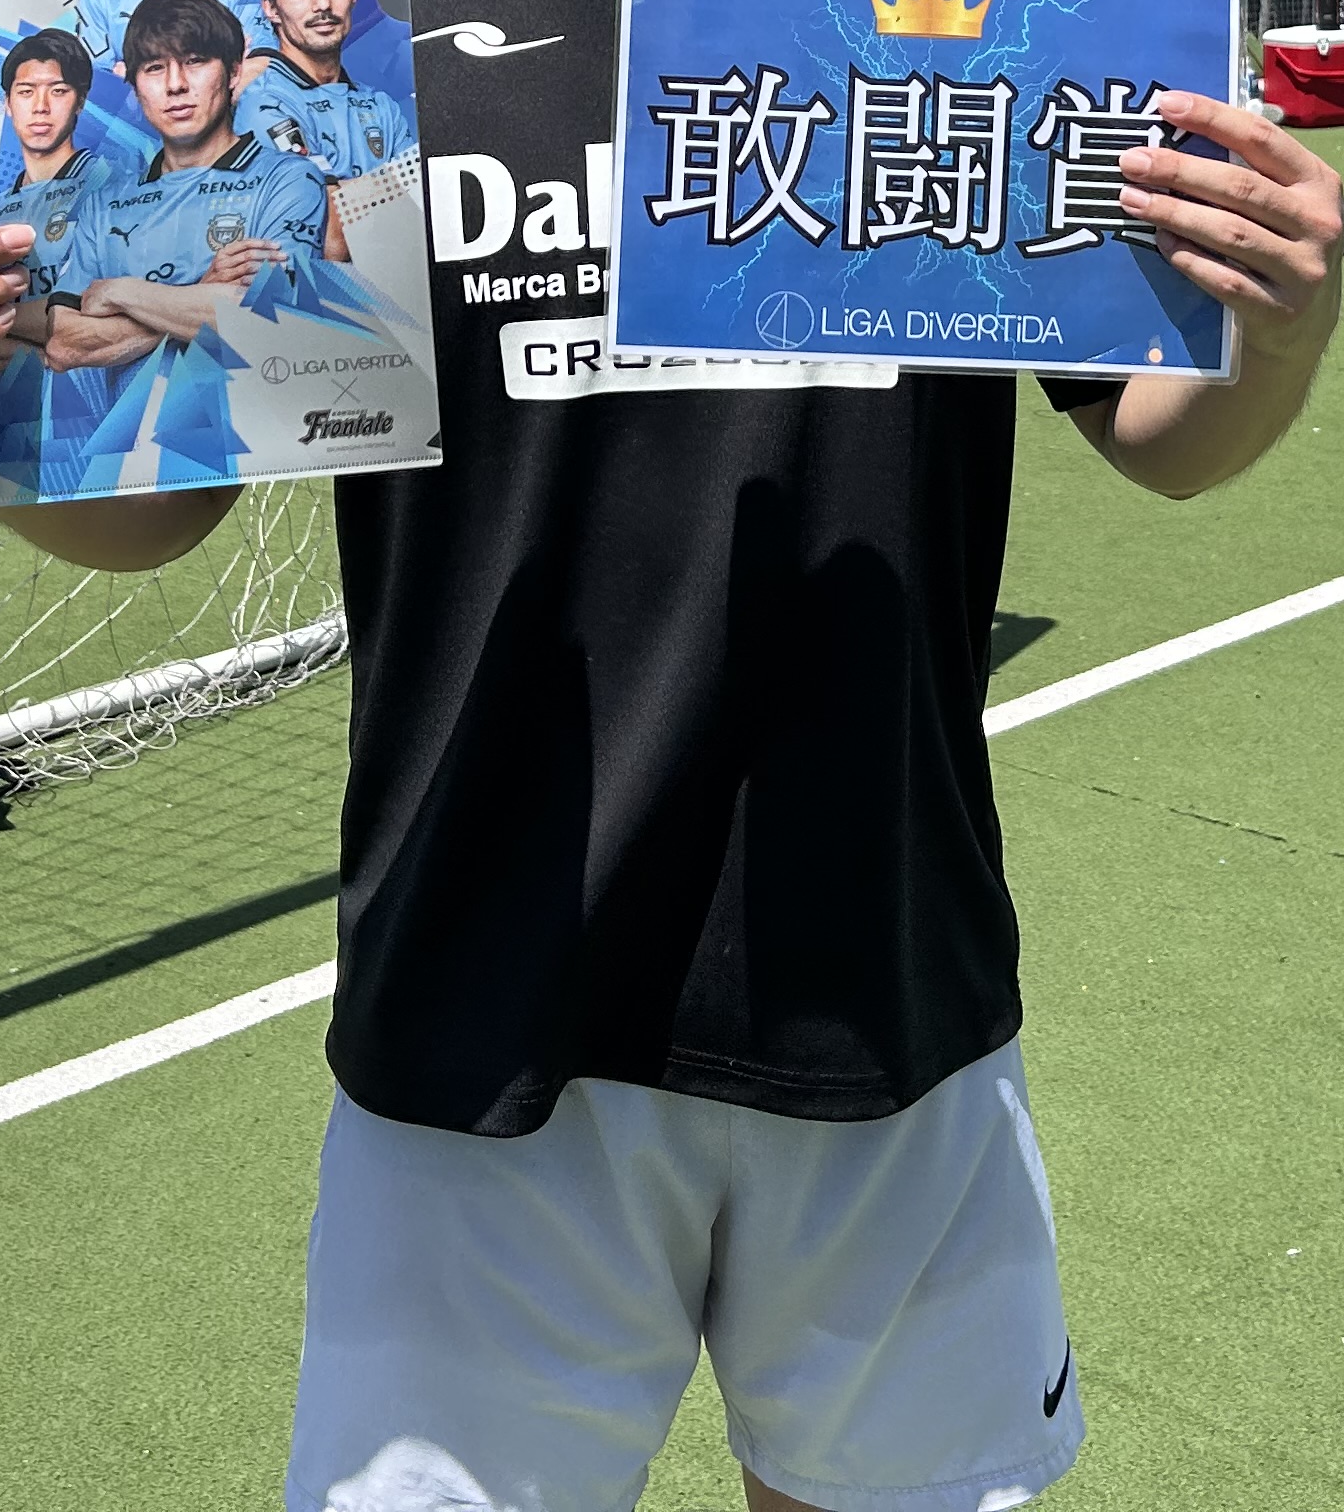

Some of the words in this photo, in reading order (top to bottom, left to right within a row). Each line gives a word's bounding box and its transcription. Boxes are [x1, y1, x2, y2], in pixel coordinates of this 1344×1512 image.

[643, 62, 1188, 258] 敢闘賞
[462, 272, 566, 304] Marca
[298, 408, 394, 445] Frontale
